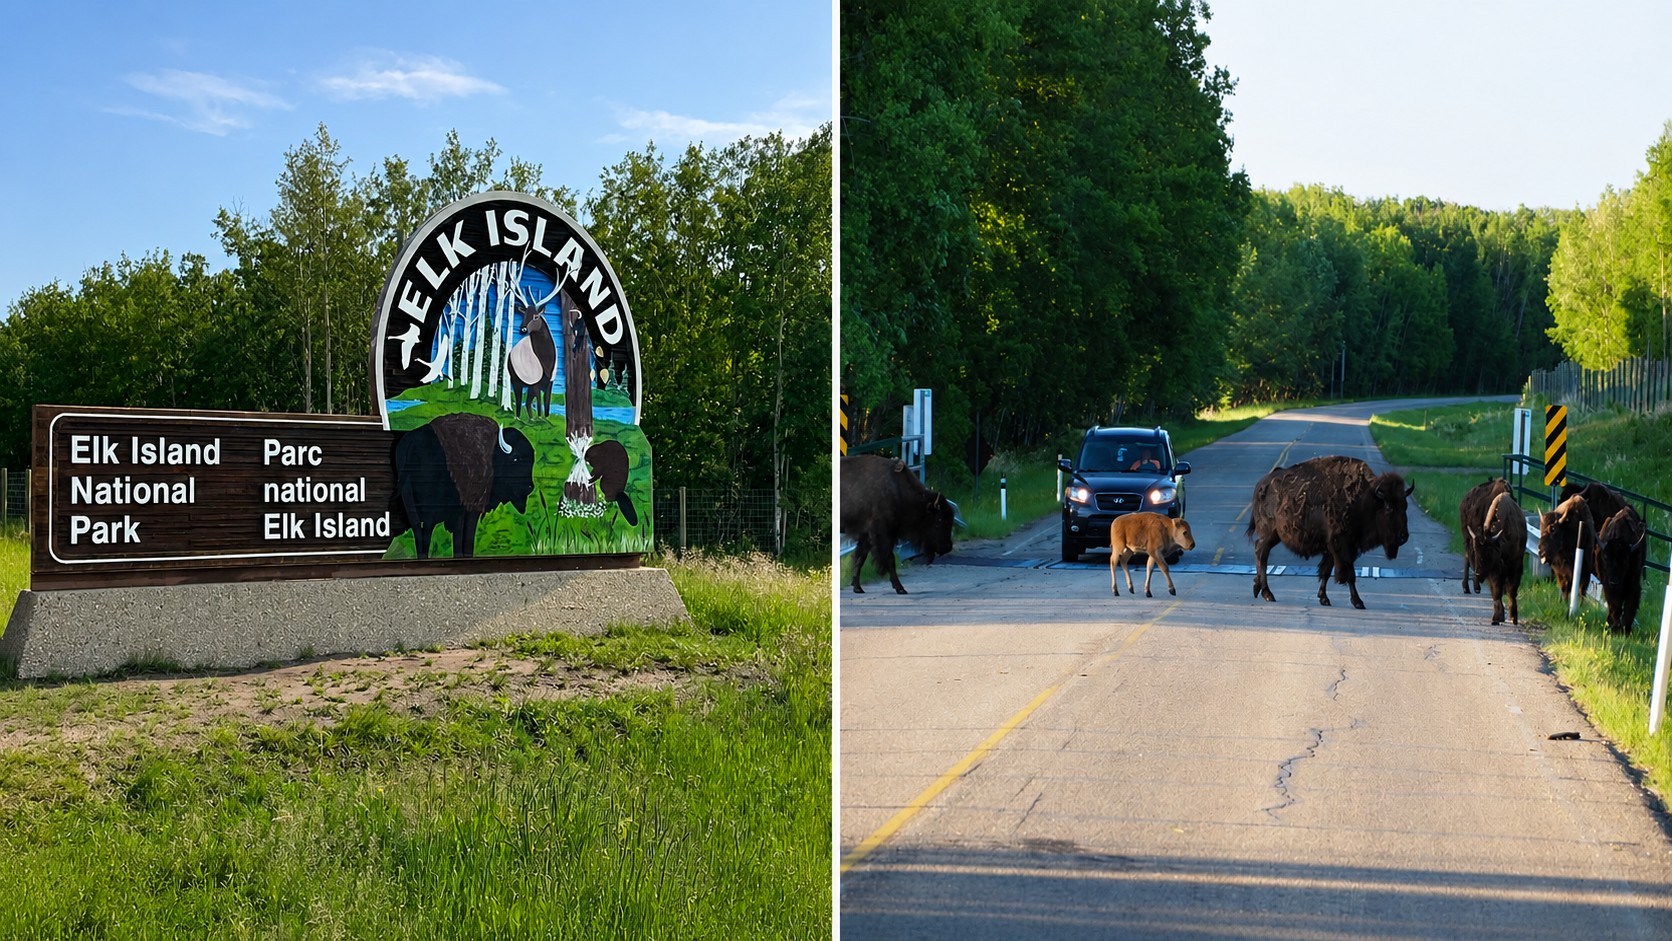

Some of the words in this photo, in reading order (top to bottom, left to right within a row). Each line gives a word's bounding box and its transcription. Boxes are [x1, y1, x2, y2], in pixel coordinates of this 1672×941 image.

[398, 220, 476, 323] ELK
[486, 210, 623, 345] ISLAND
[70, 435, 120, 465] Elk
[131, 436, 220, 465] Island
[263, 438, 323, 466] Parc
[70, 475, 195, 505] National
[264, 476, 366, 503] national
[70, 515, 141, 545] Park
[264, 512, 305, 540] Elk
[315, 511, 390, 538] Island
